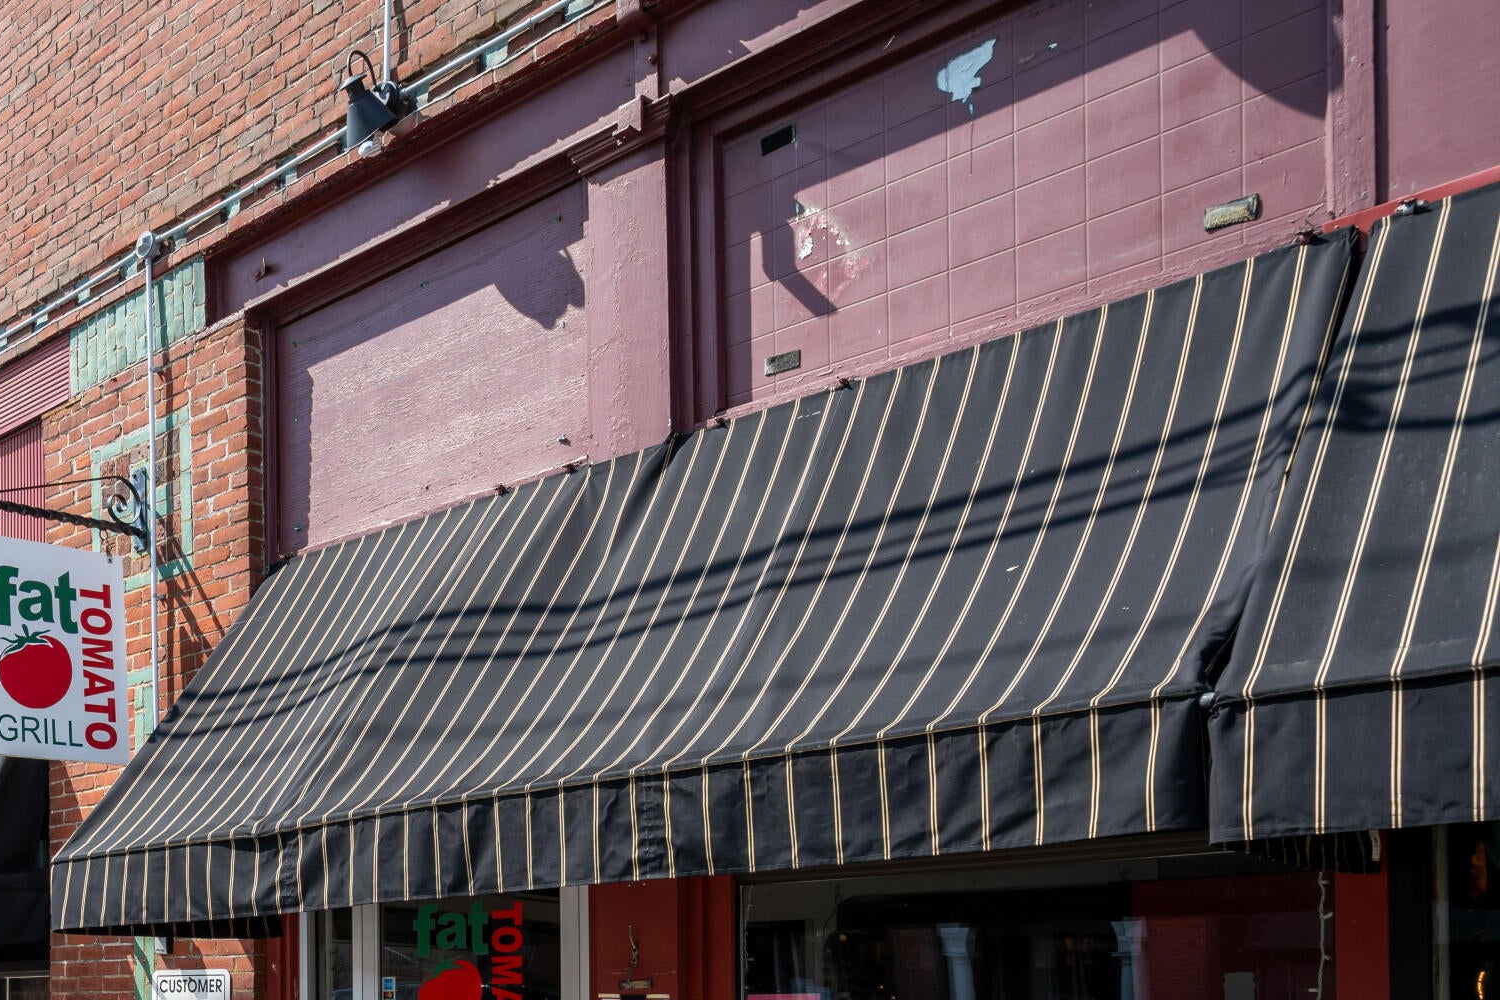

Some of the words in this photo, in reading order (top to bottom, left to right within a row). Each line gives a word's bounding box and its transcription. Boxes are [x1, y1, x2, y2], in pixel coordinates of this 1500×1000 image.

[79, 584, 118, 750] TOMATO
[413, 899, 489, 957] fat
[159, 979, 223, 993] CUSTOMER
